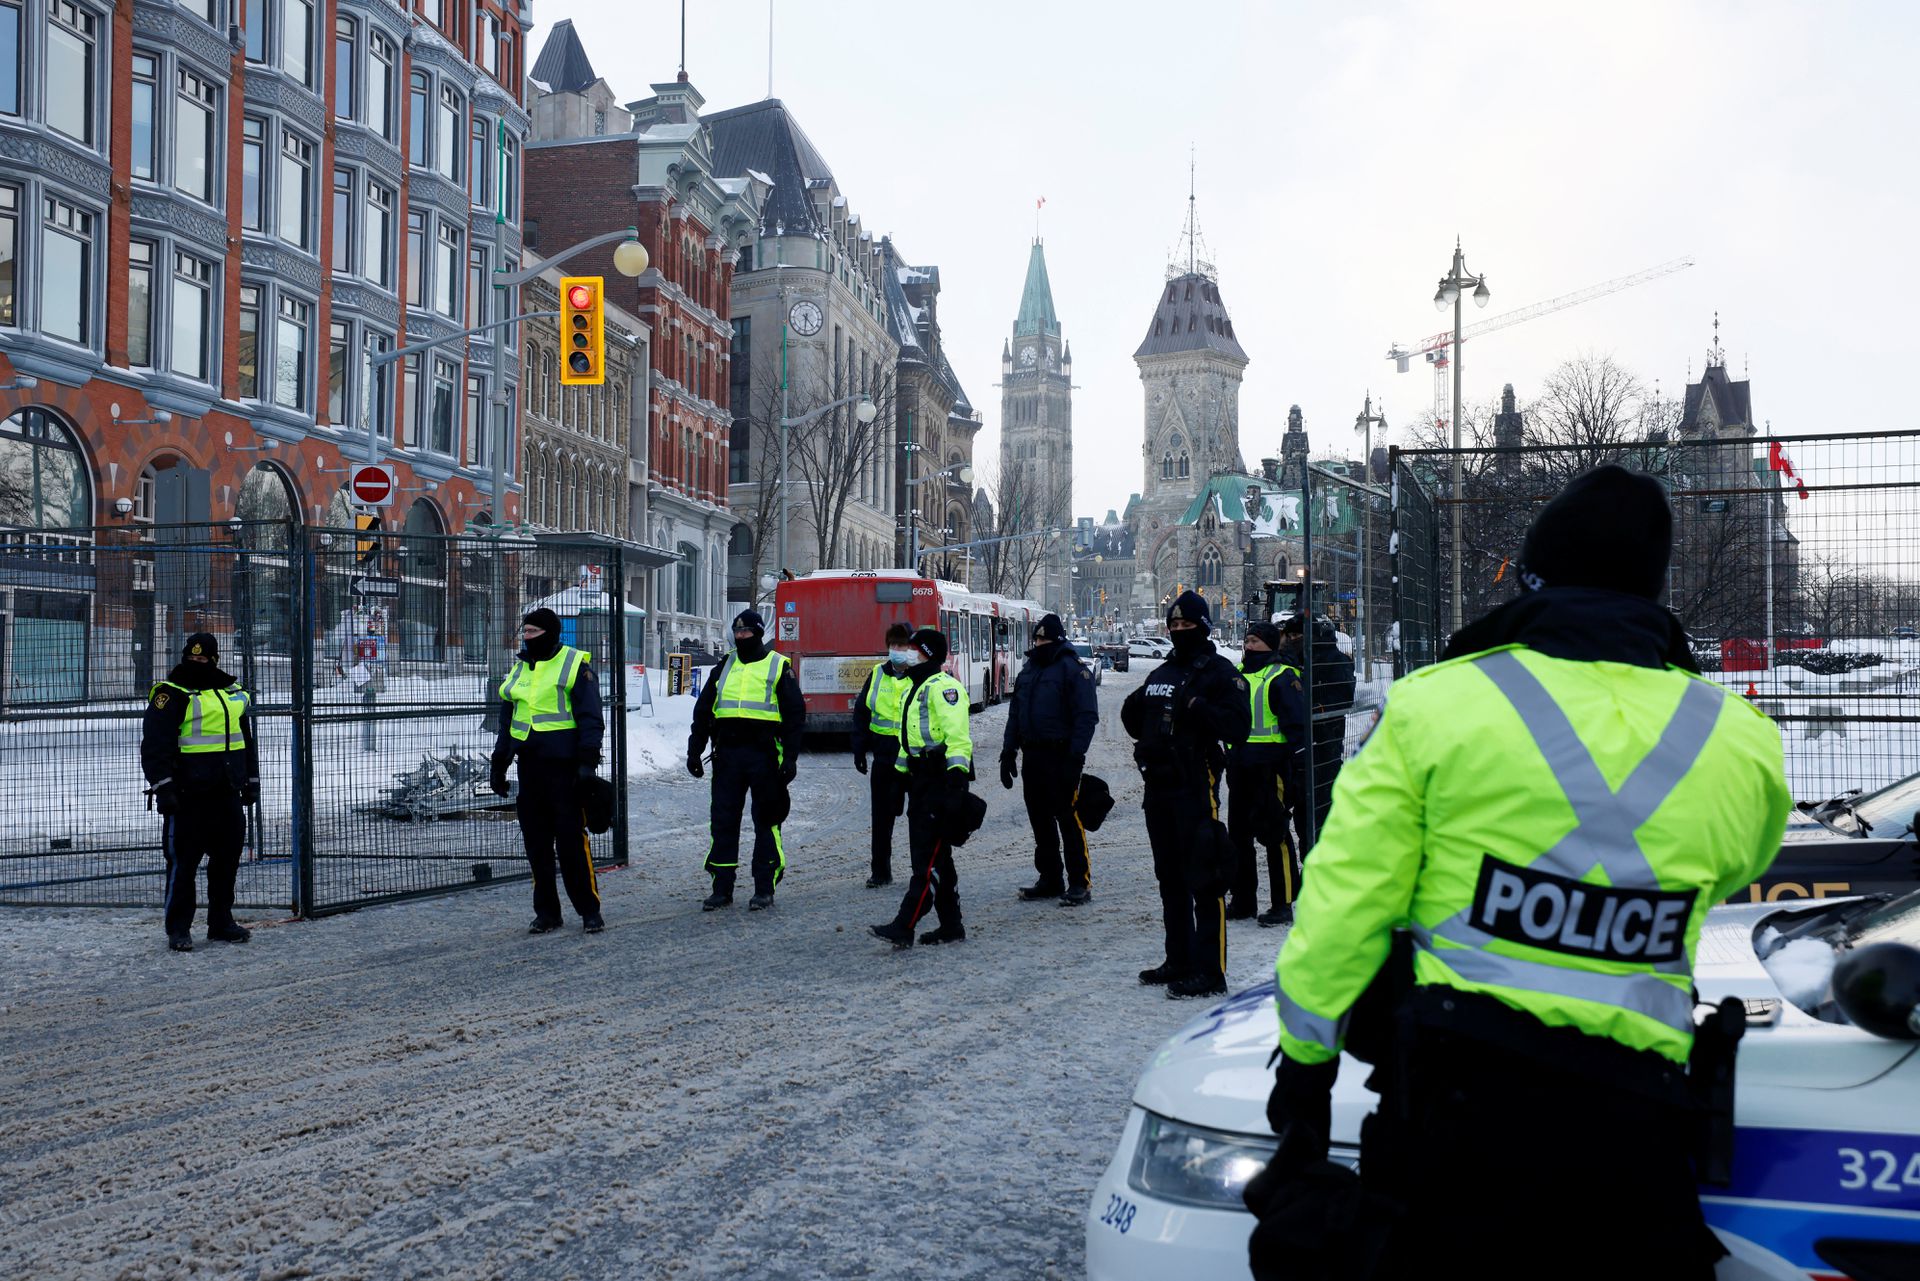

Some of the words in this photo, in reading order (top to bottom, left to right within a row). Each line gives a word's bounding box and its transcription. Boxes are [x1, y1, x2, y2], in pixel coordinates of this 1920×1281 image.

[912, 587, 934, 596] 6678
[920, 643, 934, 657] POLICE
[838, 668, 851, 678] 24
[1145, 684, 1176, 697] POLICE
[1482, 868, 1687, 957] POLICE
[1101, 1193, 1137, 1235] 3248
